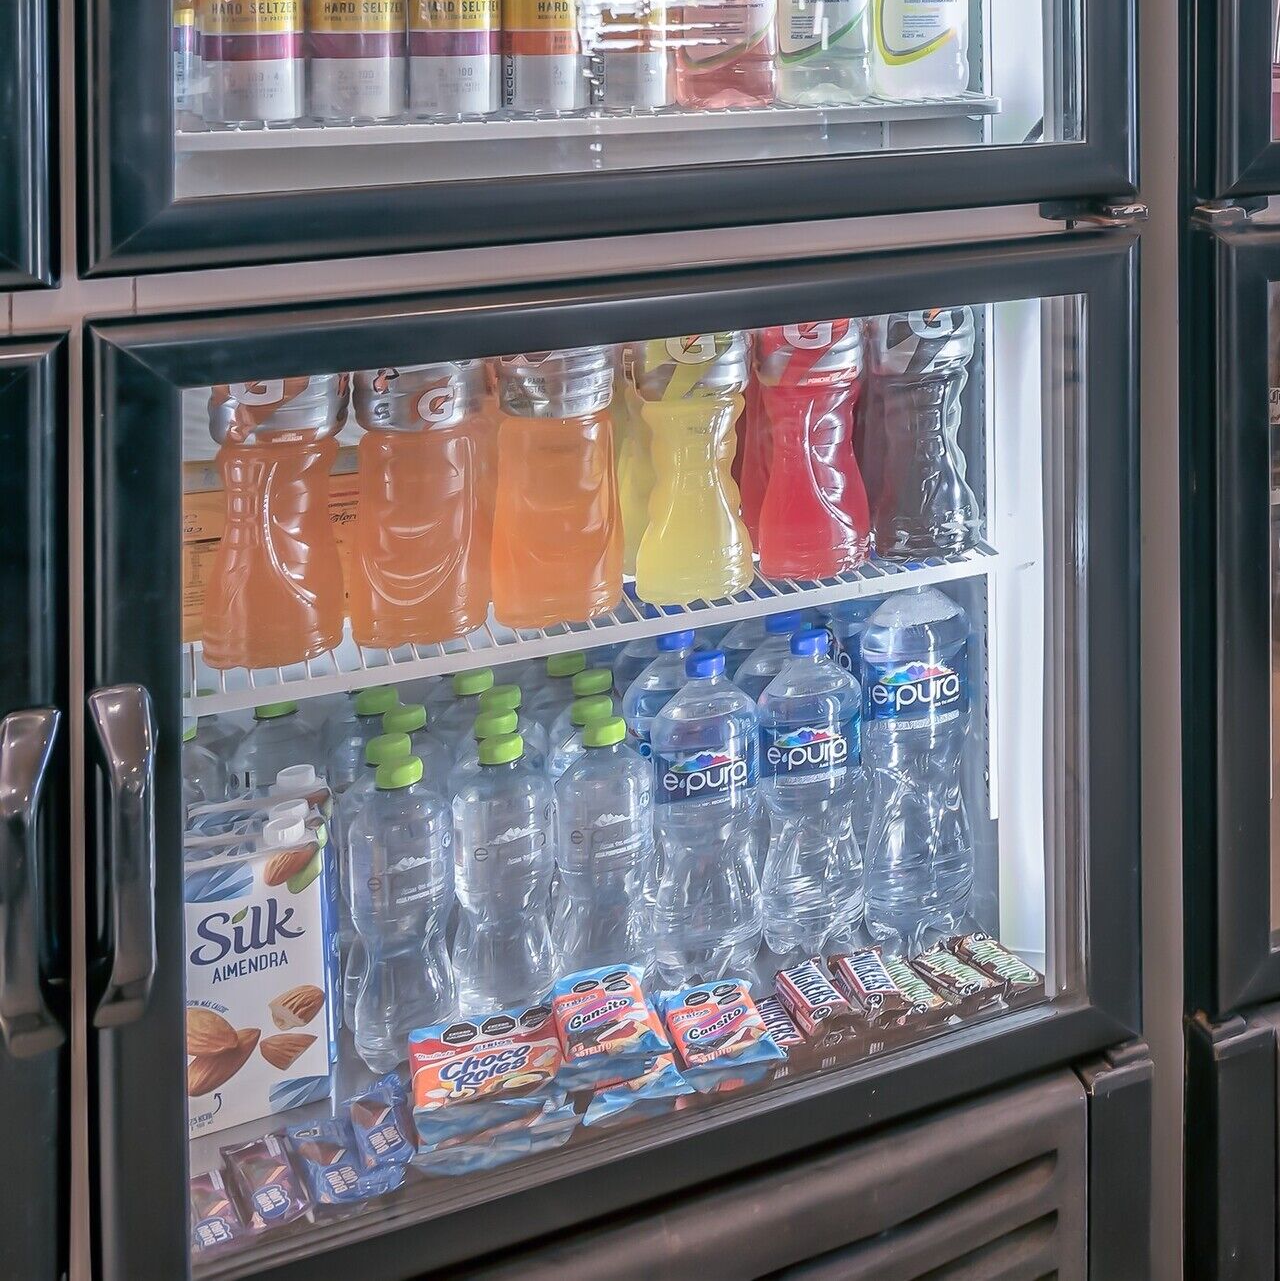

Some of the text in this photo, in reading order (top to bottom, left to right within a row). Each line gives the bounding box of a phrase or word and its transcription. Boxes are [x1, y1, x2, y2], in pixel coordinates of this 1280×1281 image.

[211, 2, 243, 15] HARD
[324, 2, 356, 15] HARD
[537, 2, 569, 12] HARD
[417, 386, 456, 422] G
[189, 897, 306, 968] Silk
[211, 951, 289, 985] ALMENDRA
[569, 997, 629, 1031] Gansito
[687, 1007, 742, 1041] Gansito
[439, 1044, 532, 1081] Choco
[454, 1055, 528, 1093] Roles
